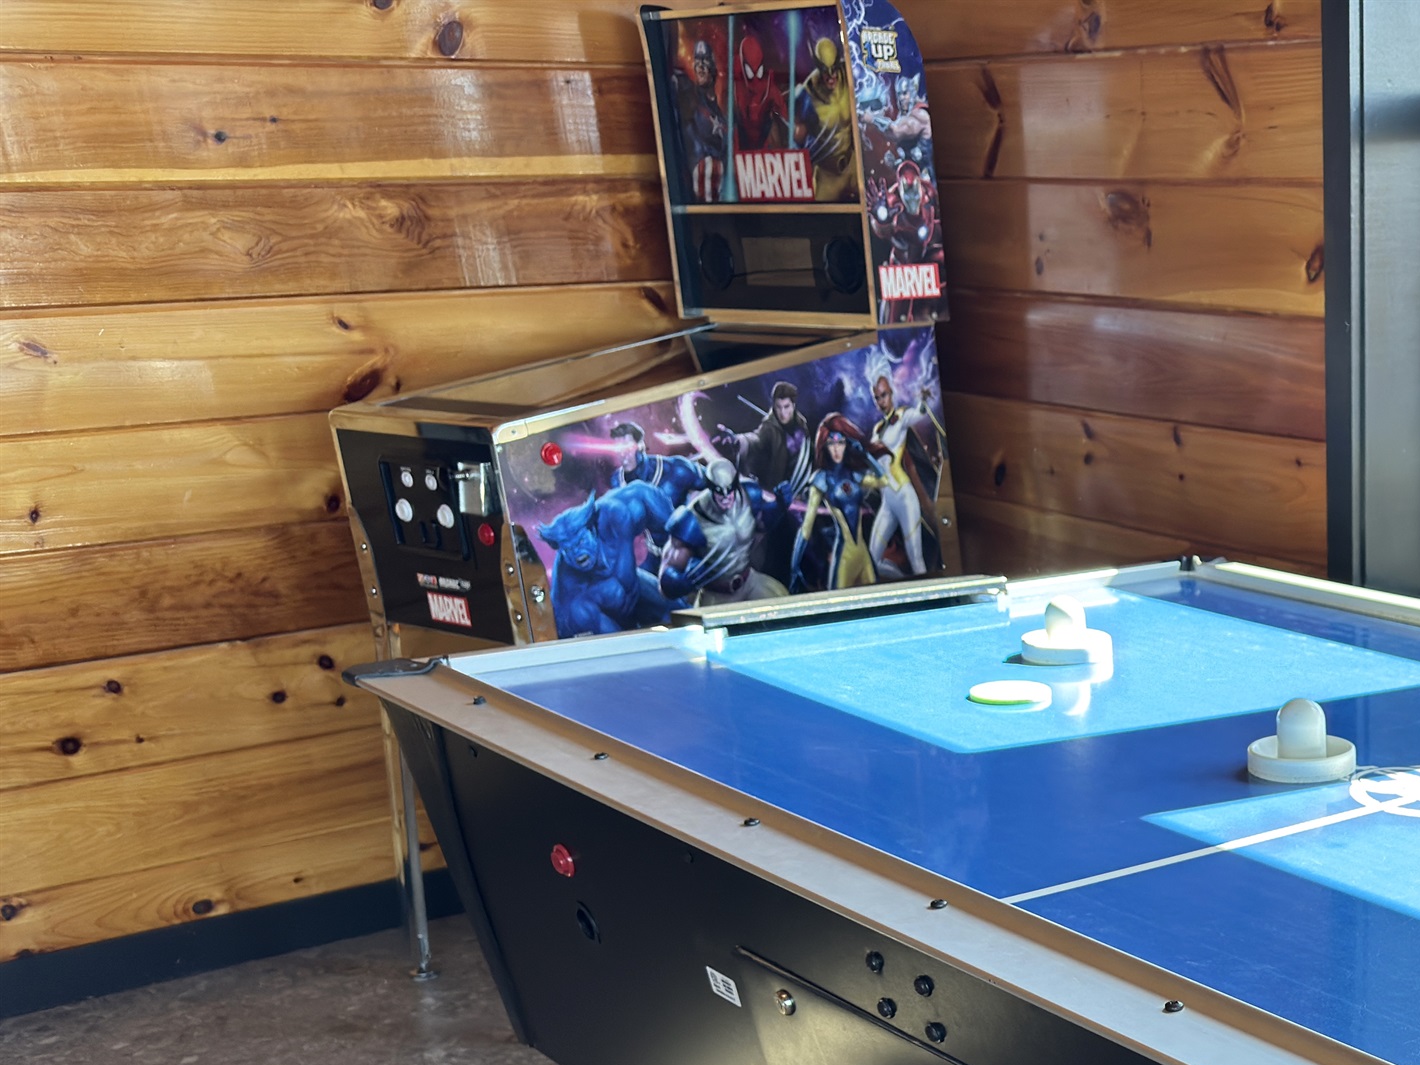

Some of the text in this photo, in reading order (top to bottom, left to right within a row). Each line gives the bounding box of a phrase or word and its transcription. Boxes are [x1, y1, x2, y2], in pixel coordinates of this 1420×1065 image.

[736, 152, 813, 198] MARVEL
[880, 265, 941, 299] MARVEL
[428, 592, 472, 626] MARVEL
